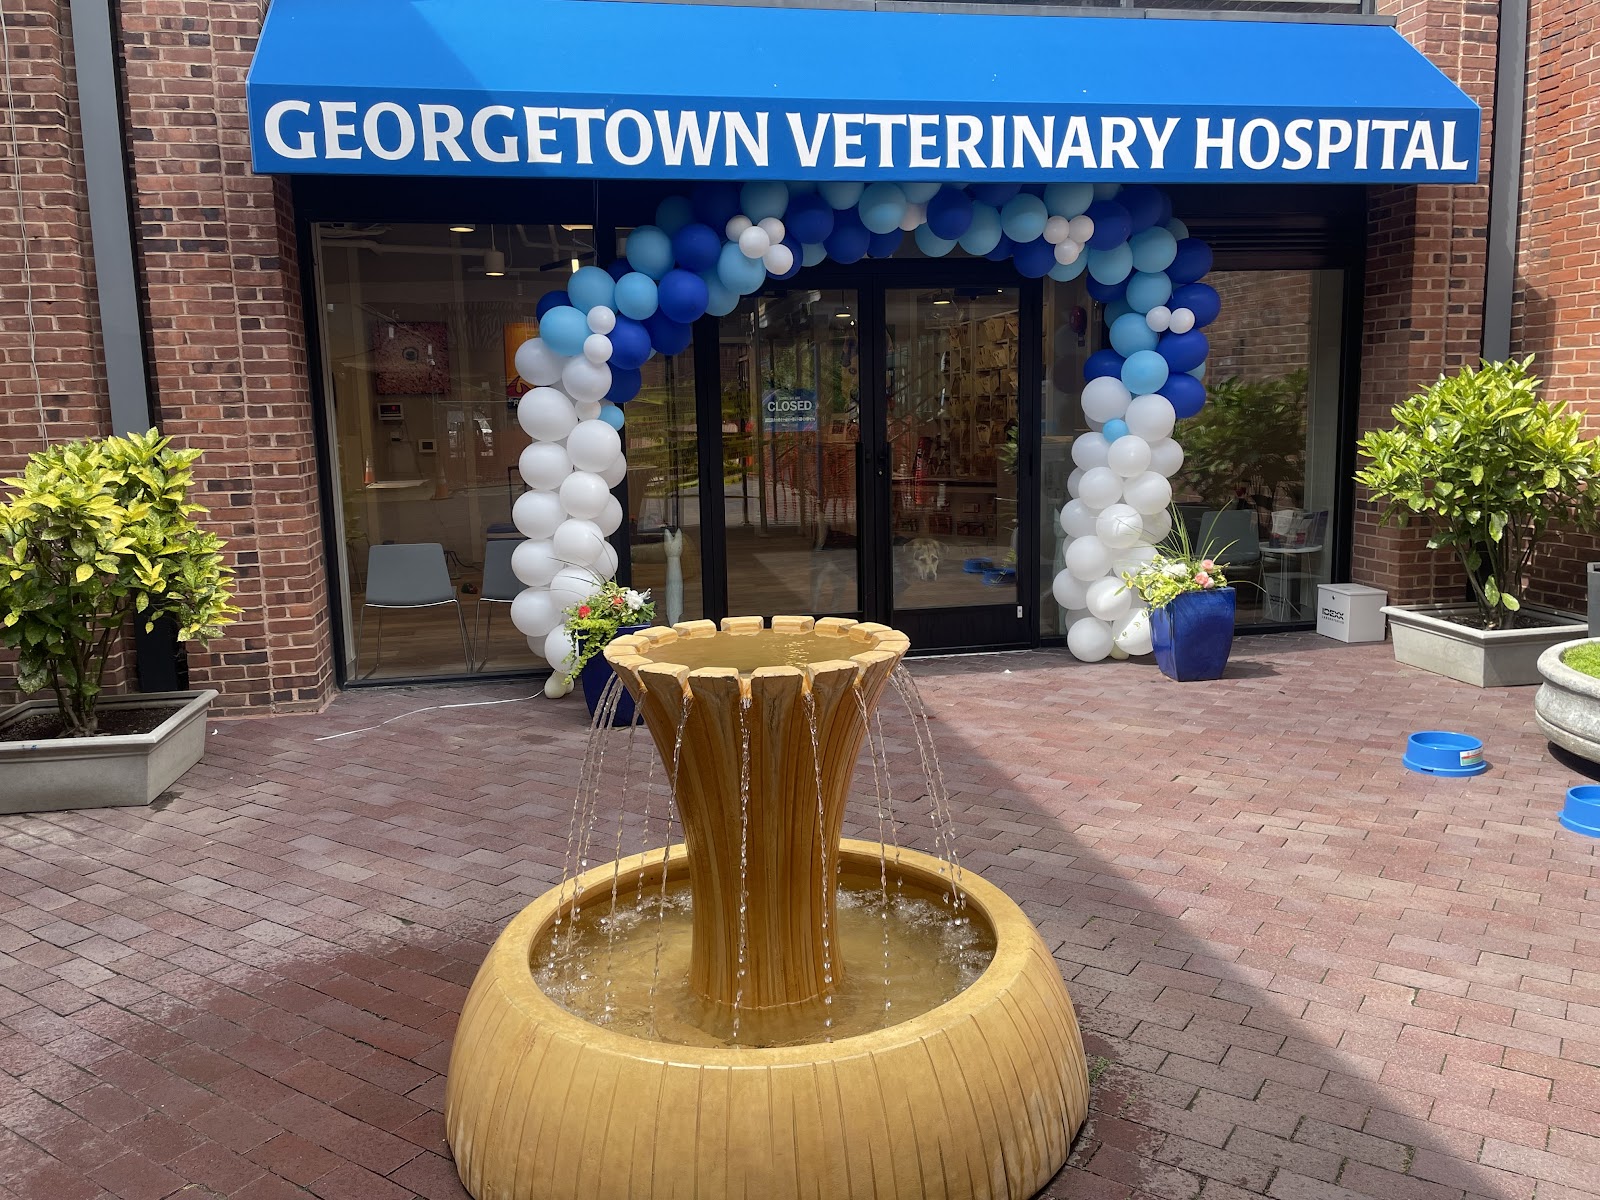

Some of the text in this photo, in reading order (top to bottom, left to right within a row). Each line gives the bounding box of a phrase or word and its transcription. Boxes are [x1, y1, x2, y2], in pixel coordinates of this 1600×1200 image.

[264, 99, 1469, 171] GEORGETOWN VETERINARY HOSPITAL
[767, 400, 812, 412] CLOSED
[1321, 607, 1345, 620] IDEXX
